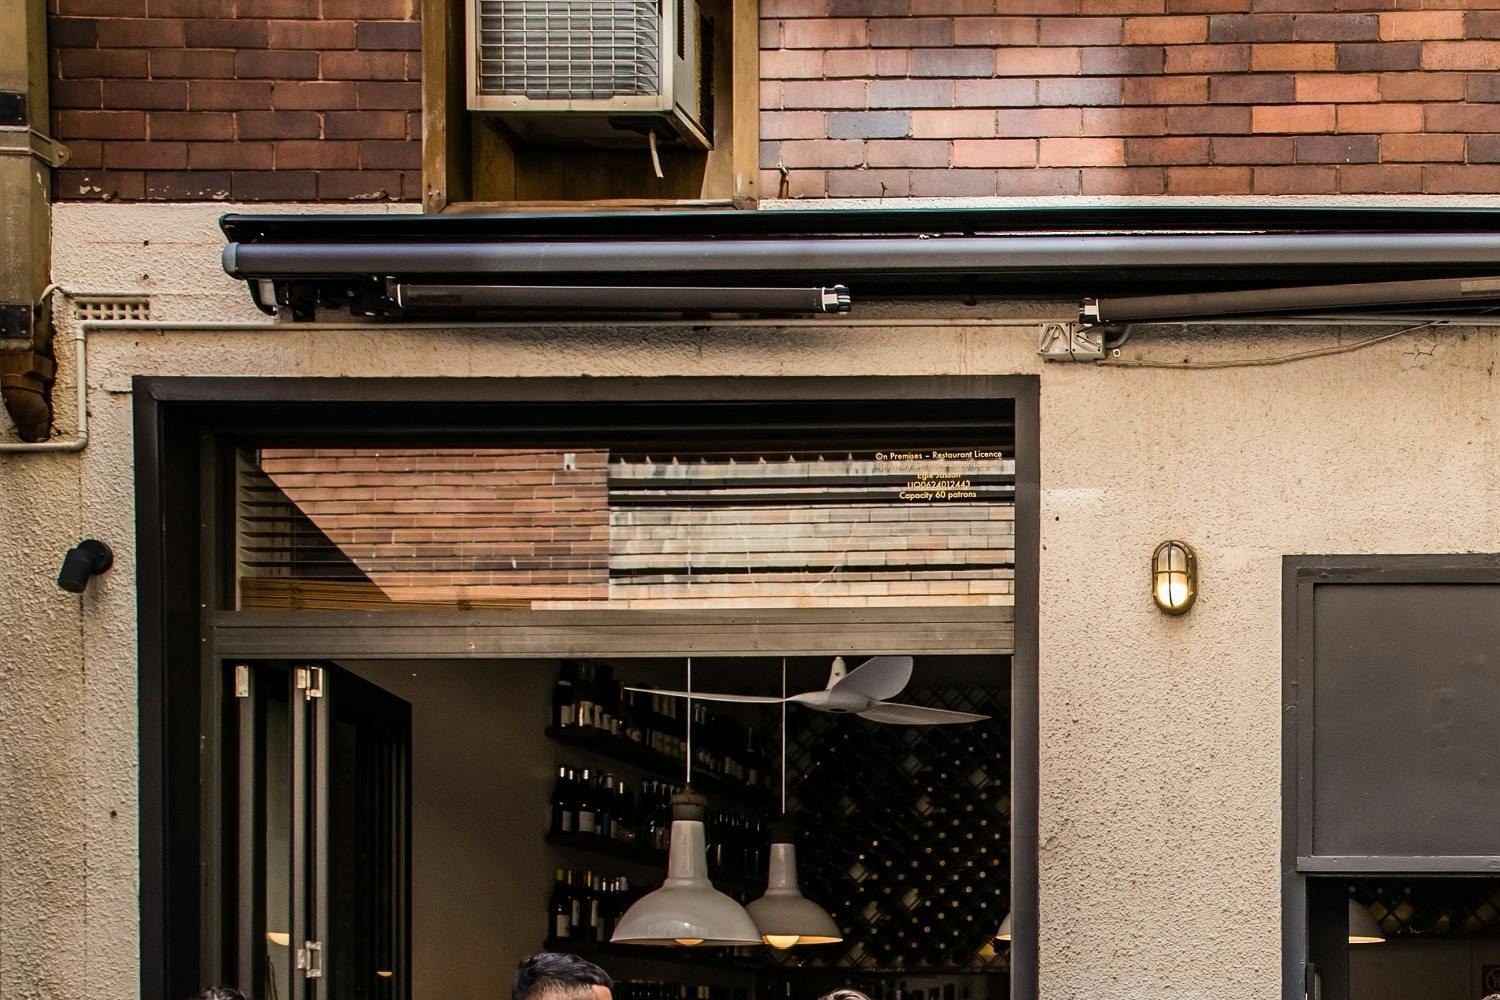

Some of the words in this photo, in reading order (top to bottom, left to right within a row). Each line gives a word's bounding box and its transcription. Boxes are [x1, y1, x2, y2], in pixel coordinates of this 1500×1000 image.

[875, 452, 888, 461] On
[890, 452, 923, 461] Premises
[932, 451, 974, 460] Restaurant
[974, 450, 1002, 459] Licence
[899, 490, 933, 500] Capacity
[935, 491, 946, 499] 60
[947, 491, 977, 500] patrons
